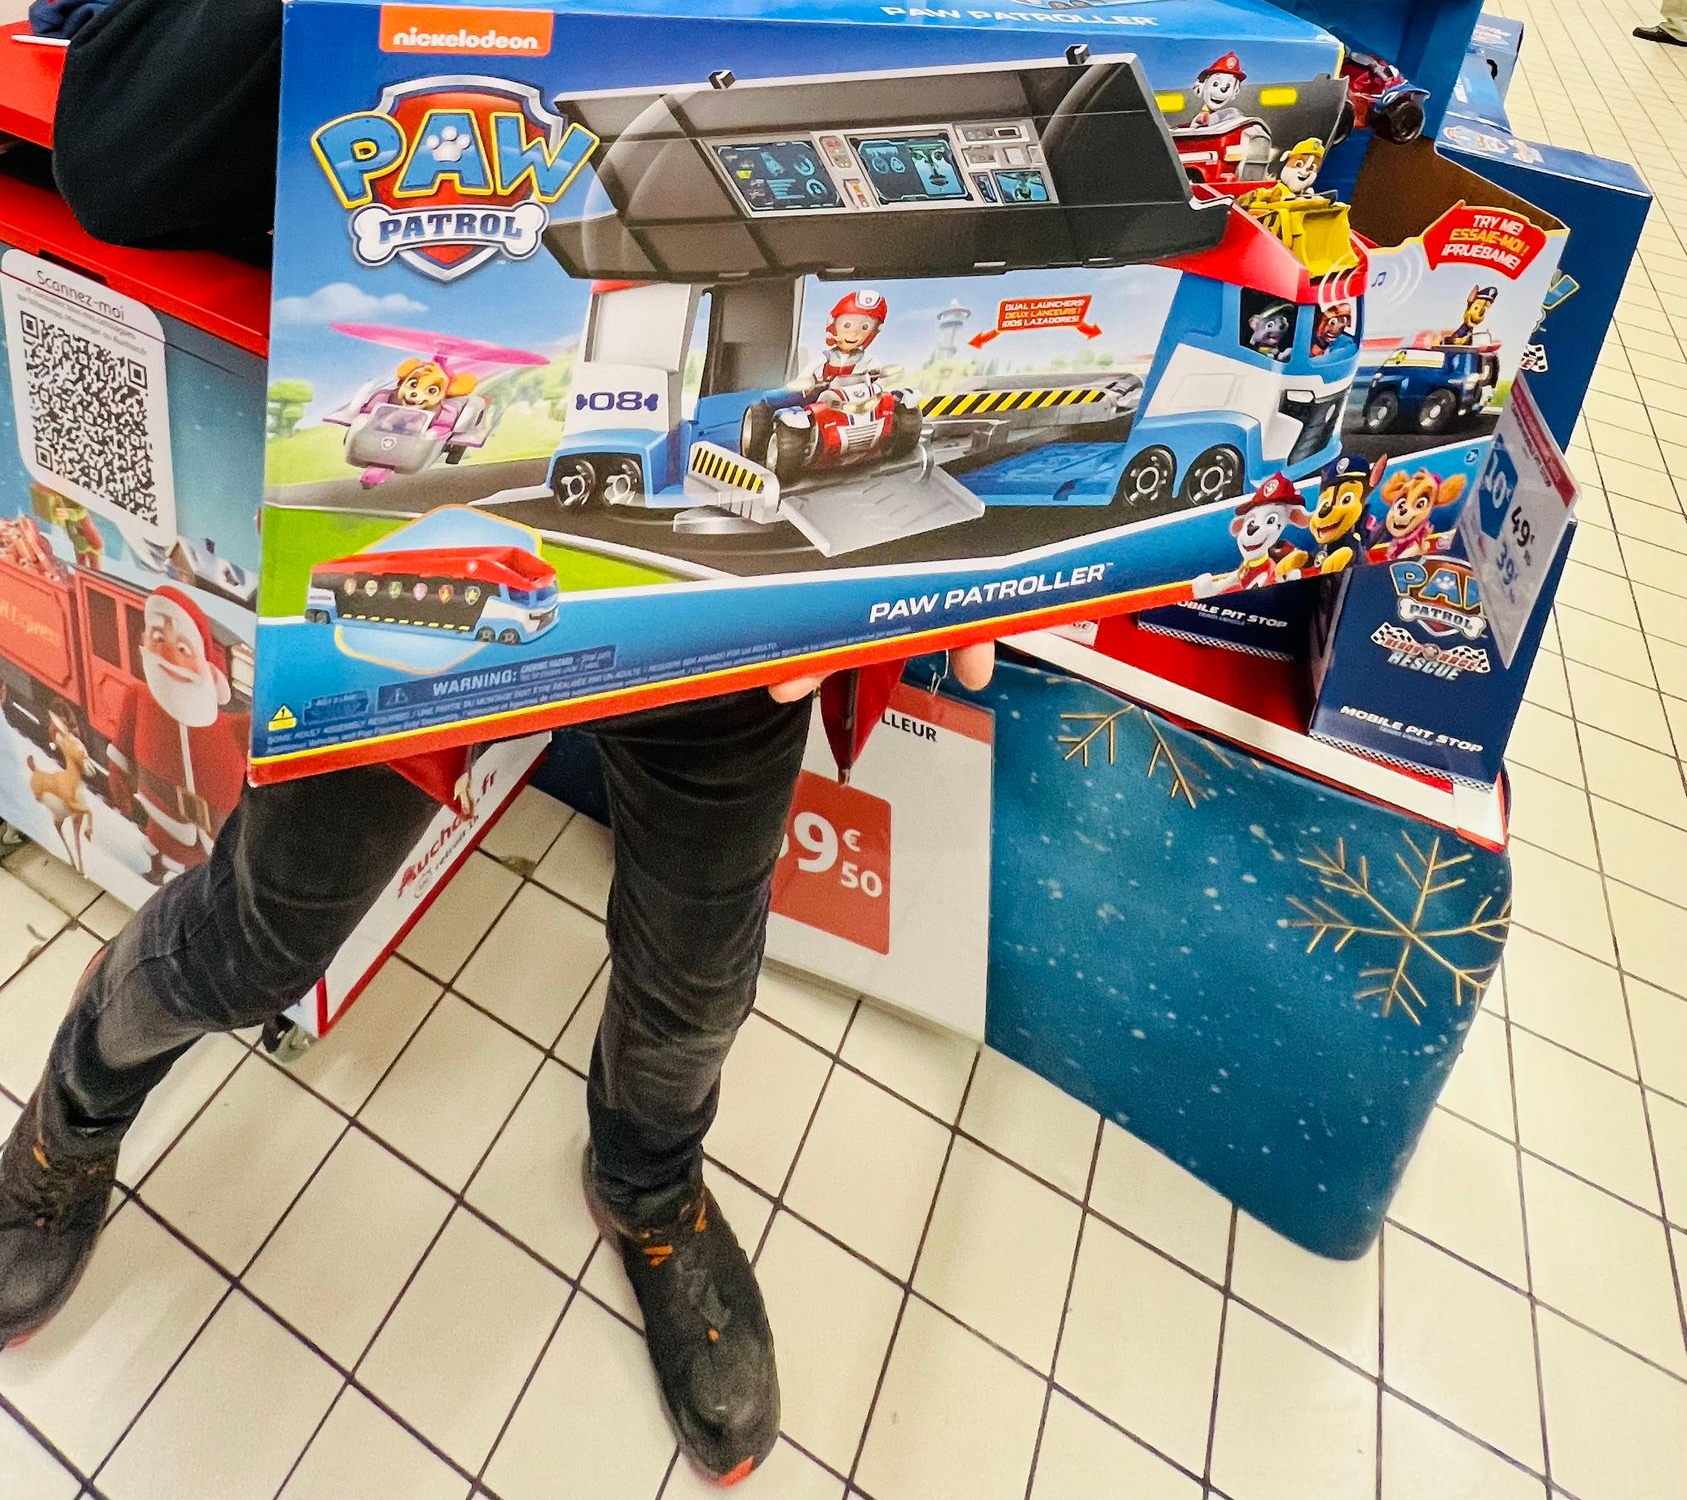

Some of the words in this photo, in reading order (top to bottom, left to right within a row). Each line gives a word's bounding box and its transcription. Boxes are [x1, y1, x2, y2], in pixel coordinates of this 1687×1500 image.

[879, 5, 962, 20] PAW
[965, 9, 1160, 26] PATROLLER
[393, 26, 538, 50] nickelodeon
[311, 107, 600, 210] PAW
[378, 214, 523, 245] PATROL
[1473, 214, 1502, 229] TRY
[36, 270, 125, 321] Scannez-moi
[1004, 303, 1029, 312] DUAL
[589, 391, 643, 411] 08
[868, 593, 942, 625] PAW
[1175, 600, 1219, 614] OBILE
[1221, 608, 1246, 622] PIT
[1246, 614, 1288, 628] STOP
[1409, 604, 1473, 630] PATROL
[1387, 651, 1459, 681] RESCUE
[433, 668, 518, 697] WARNING:
[881, 713, 937, 743] LLEUR
[1340, 705, 1403, 731] MOBILE
[1405, 725, 1434, 739] PIT
[1435, 734, 1484, 752] STOP
[779, 811, 861, 873] 9€
